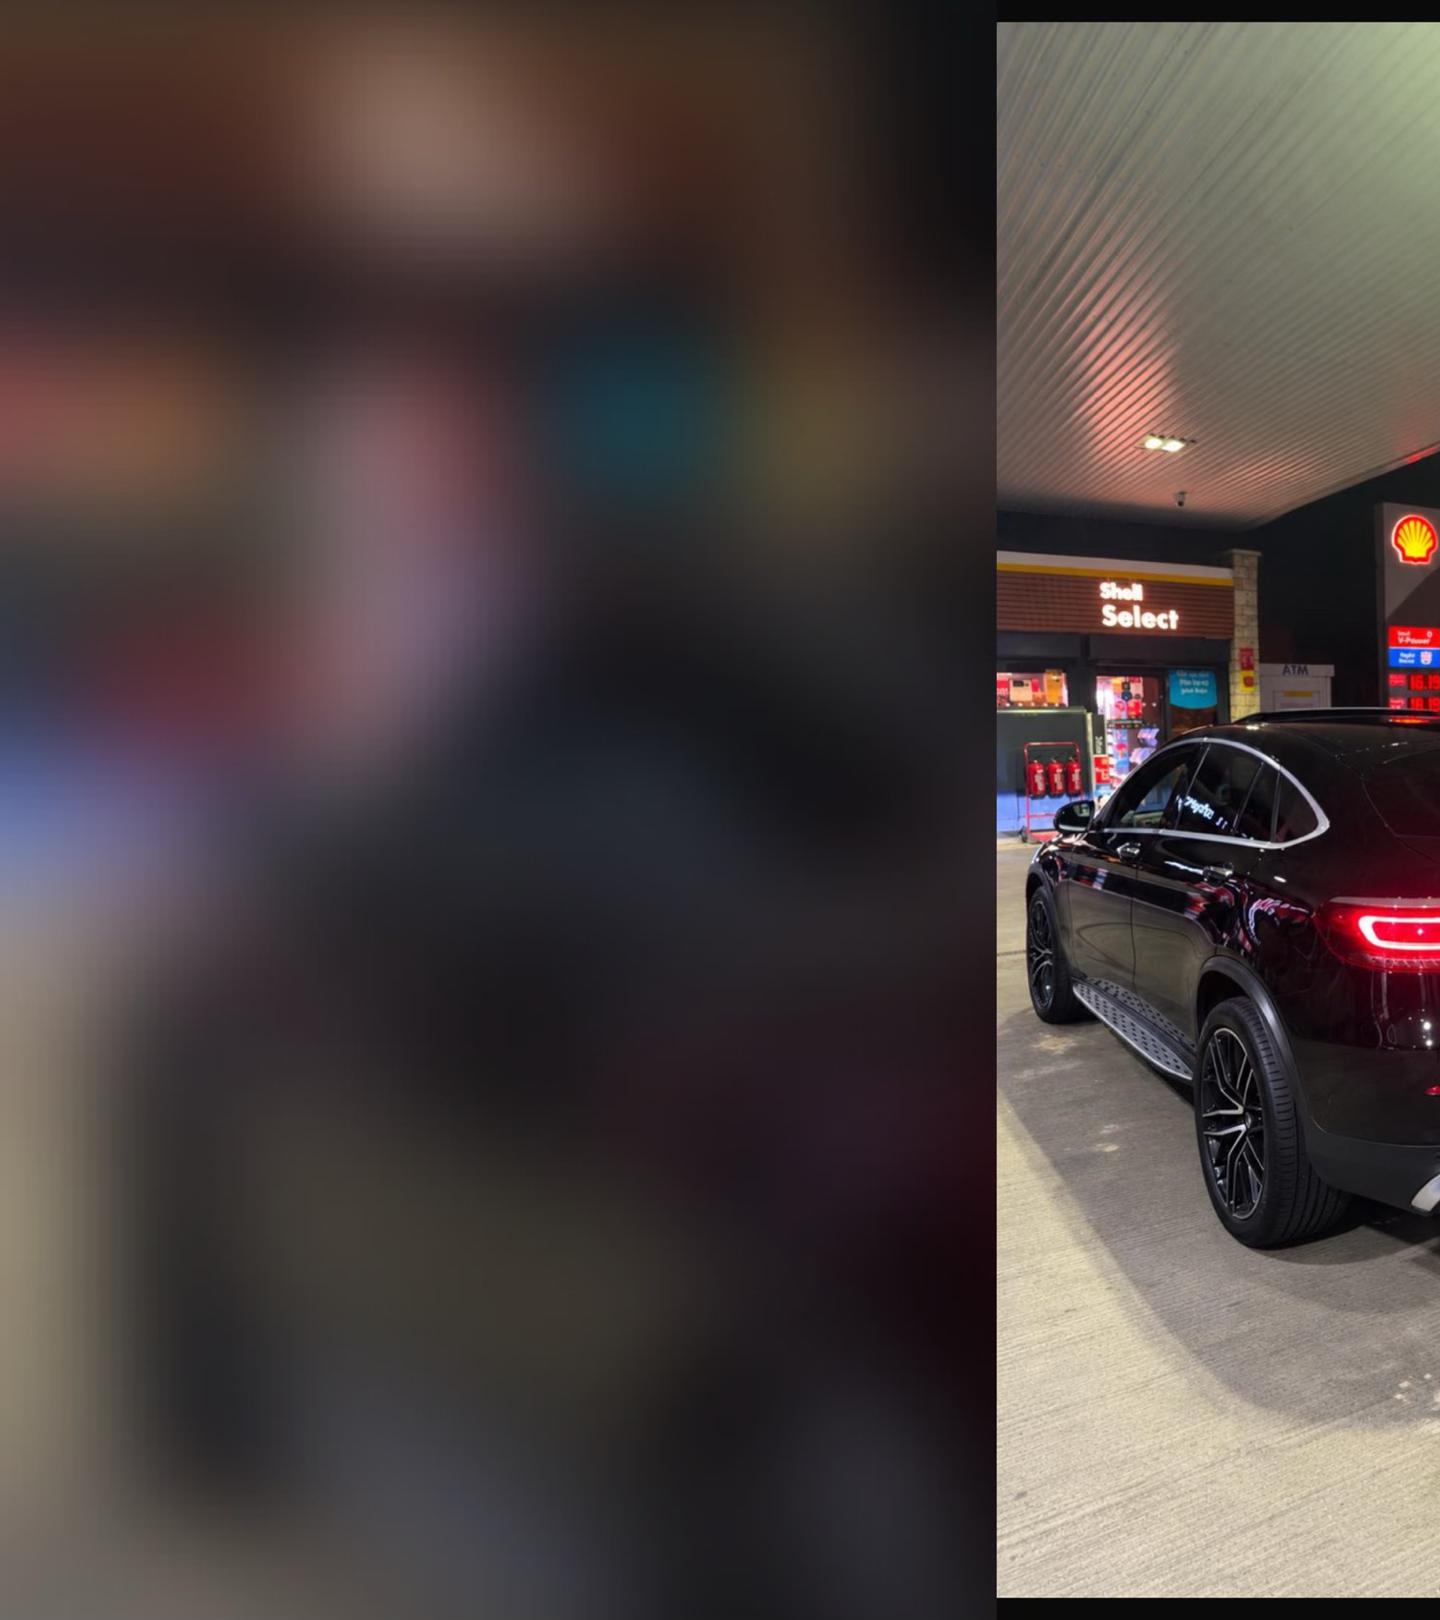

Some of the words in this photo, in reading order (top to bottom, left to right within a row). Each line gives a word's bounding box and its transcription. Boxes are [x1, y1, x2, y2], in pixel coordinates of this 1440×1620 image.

[1099, 582, 1143, 601] Shell
[1102, 604, 1179, 630] Select
[1282, 664, 1309, 676] ATM
